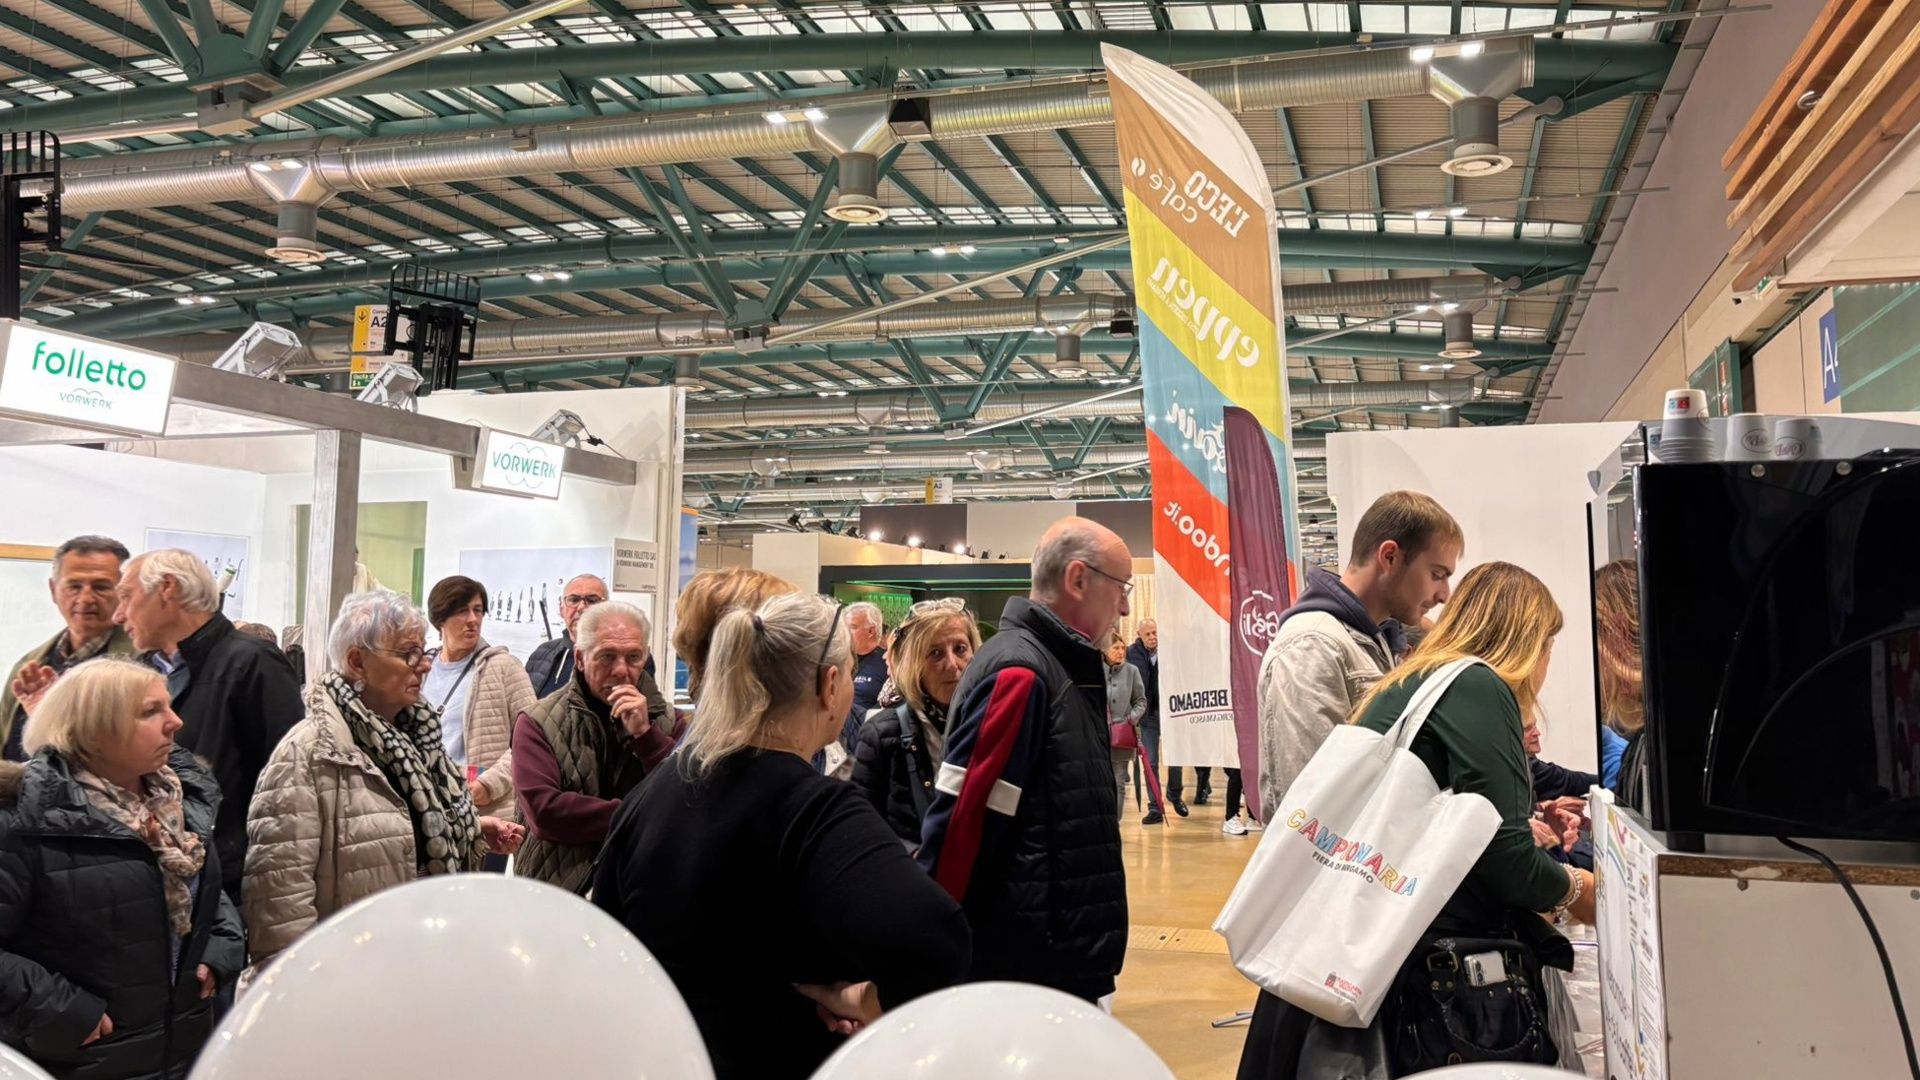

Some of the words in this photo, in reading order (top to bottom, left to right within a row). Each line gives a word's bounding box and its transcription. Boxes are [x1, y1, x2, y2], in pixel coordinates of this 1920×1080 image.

[32, 341, 146, 391] folletto
[1823, 327, 1839, 389] A
[59, 392, 112, 409] VORWERK
[493, 452, 556, 478] VORWERK
[1312, 851, 1335, 868] FIERA
